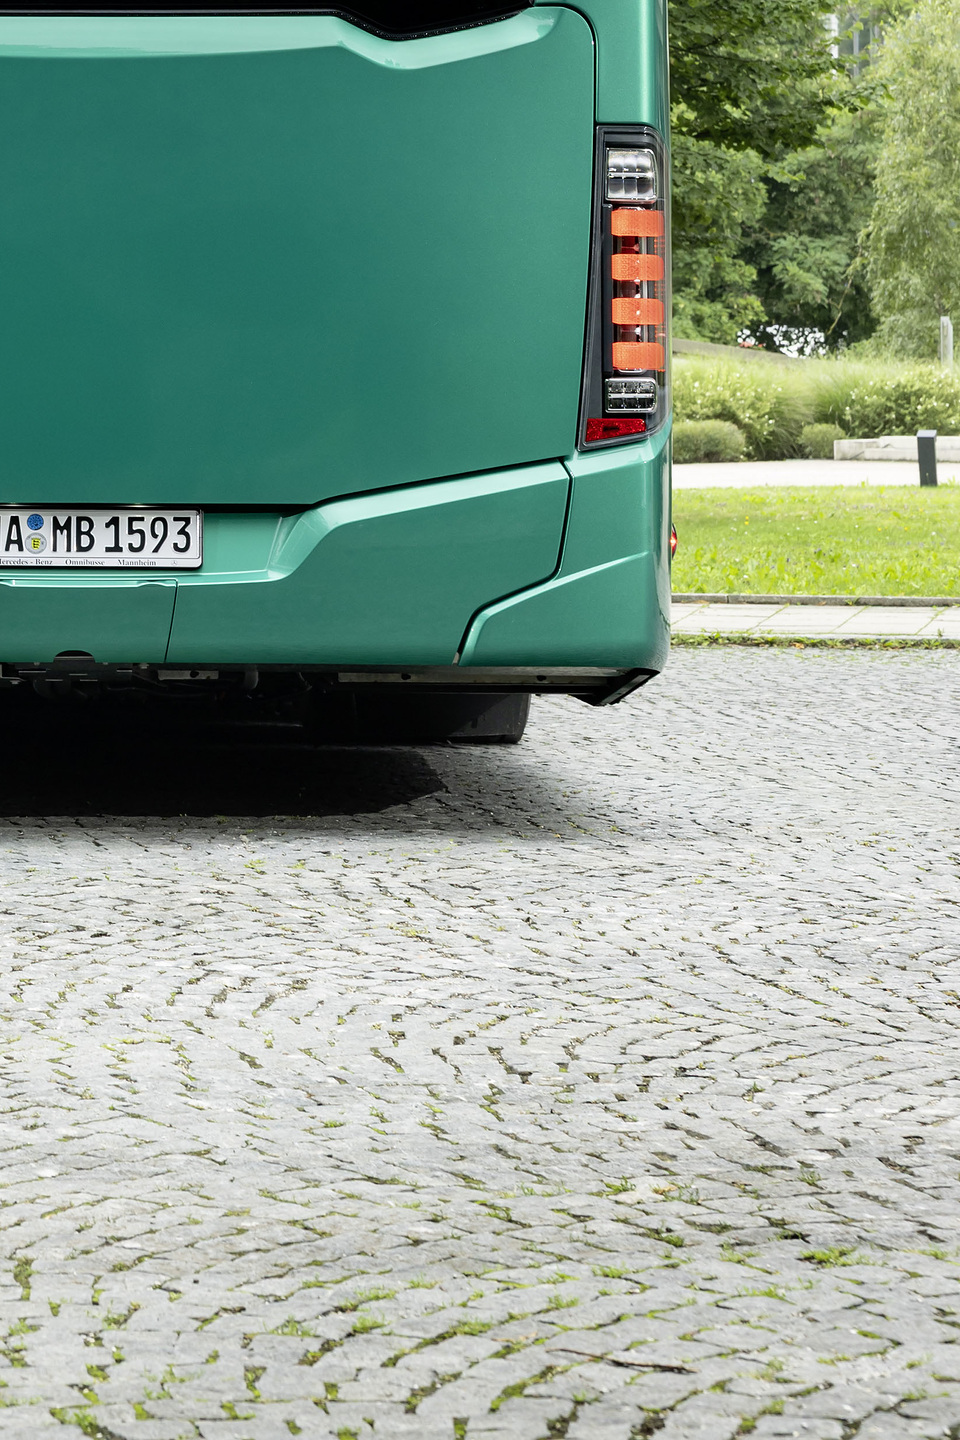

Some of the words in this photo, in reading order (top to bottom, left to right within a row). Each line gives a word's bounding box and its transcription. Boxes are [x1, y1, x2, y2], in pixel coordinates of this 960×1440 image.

[52, 515, 96, 552] MB
[104, 516, 192, 553] 1593
[65, 558, 105, 566] Omnibusse
[118, 558, 156, 566] Mannheim
